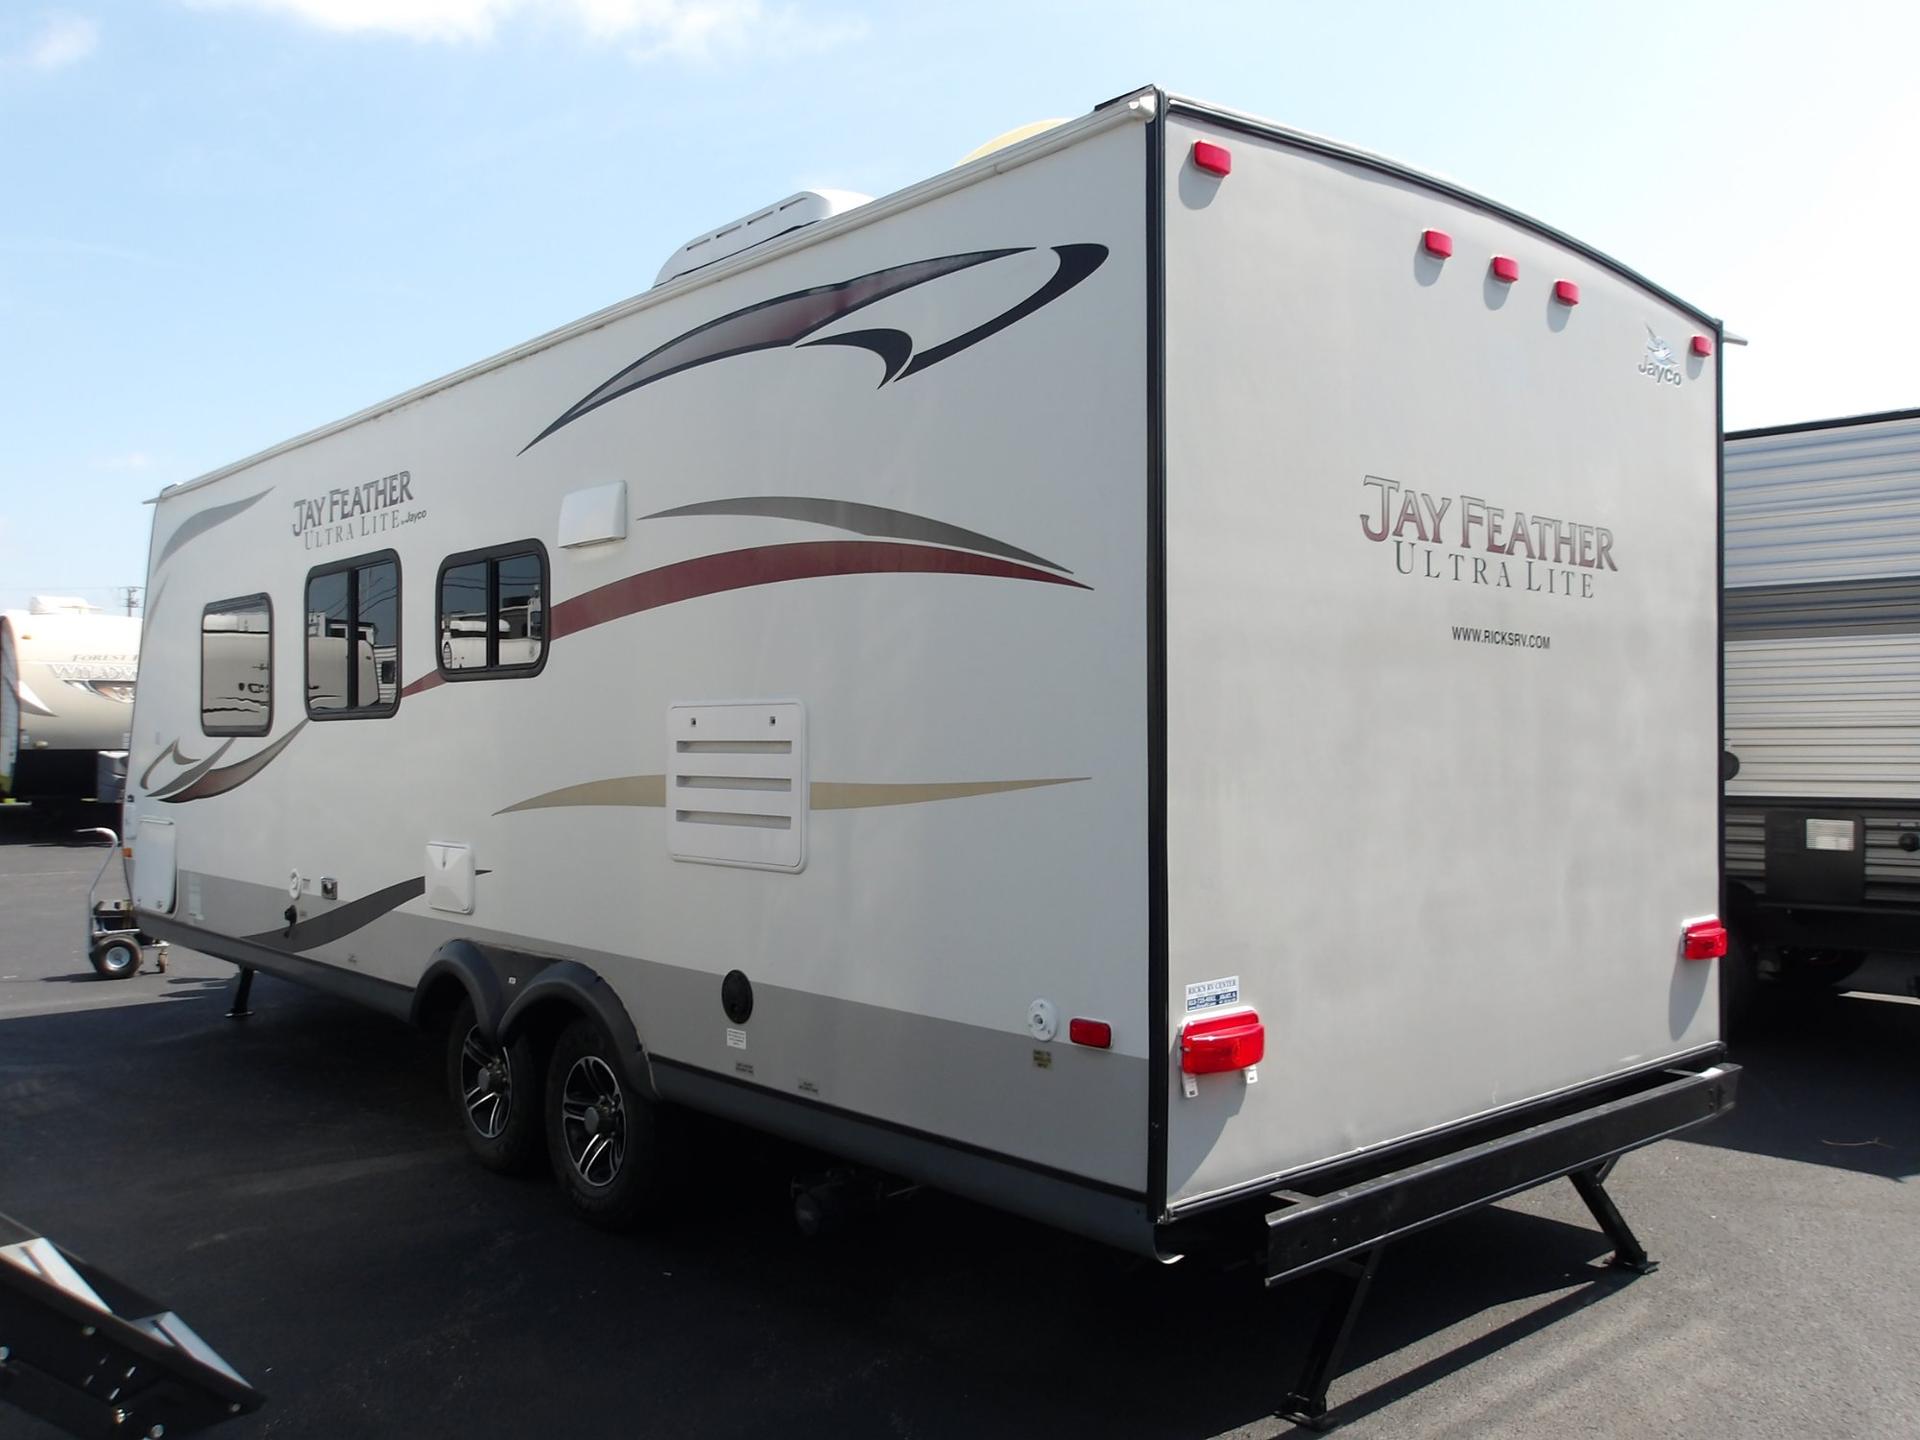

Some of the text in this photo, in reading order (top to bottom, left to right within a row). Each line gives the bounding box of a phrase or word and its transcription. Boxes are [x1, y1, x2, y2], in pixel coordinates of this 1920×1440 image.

[1638, 354, 1682, 386] Jayco
[292, 470, 414, 537] JAY FEATHER
[1360, 475, 1618, 572] JAY FEATHER
[304, 522, 354, 550] ULTRA
[361, 509, 400, 536] LITE
[1394, 540, 1595, 599] ULTRA LITE
[1452, 626, 1550, 649] WWW.RICKSRV.COM
